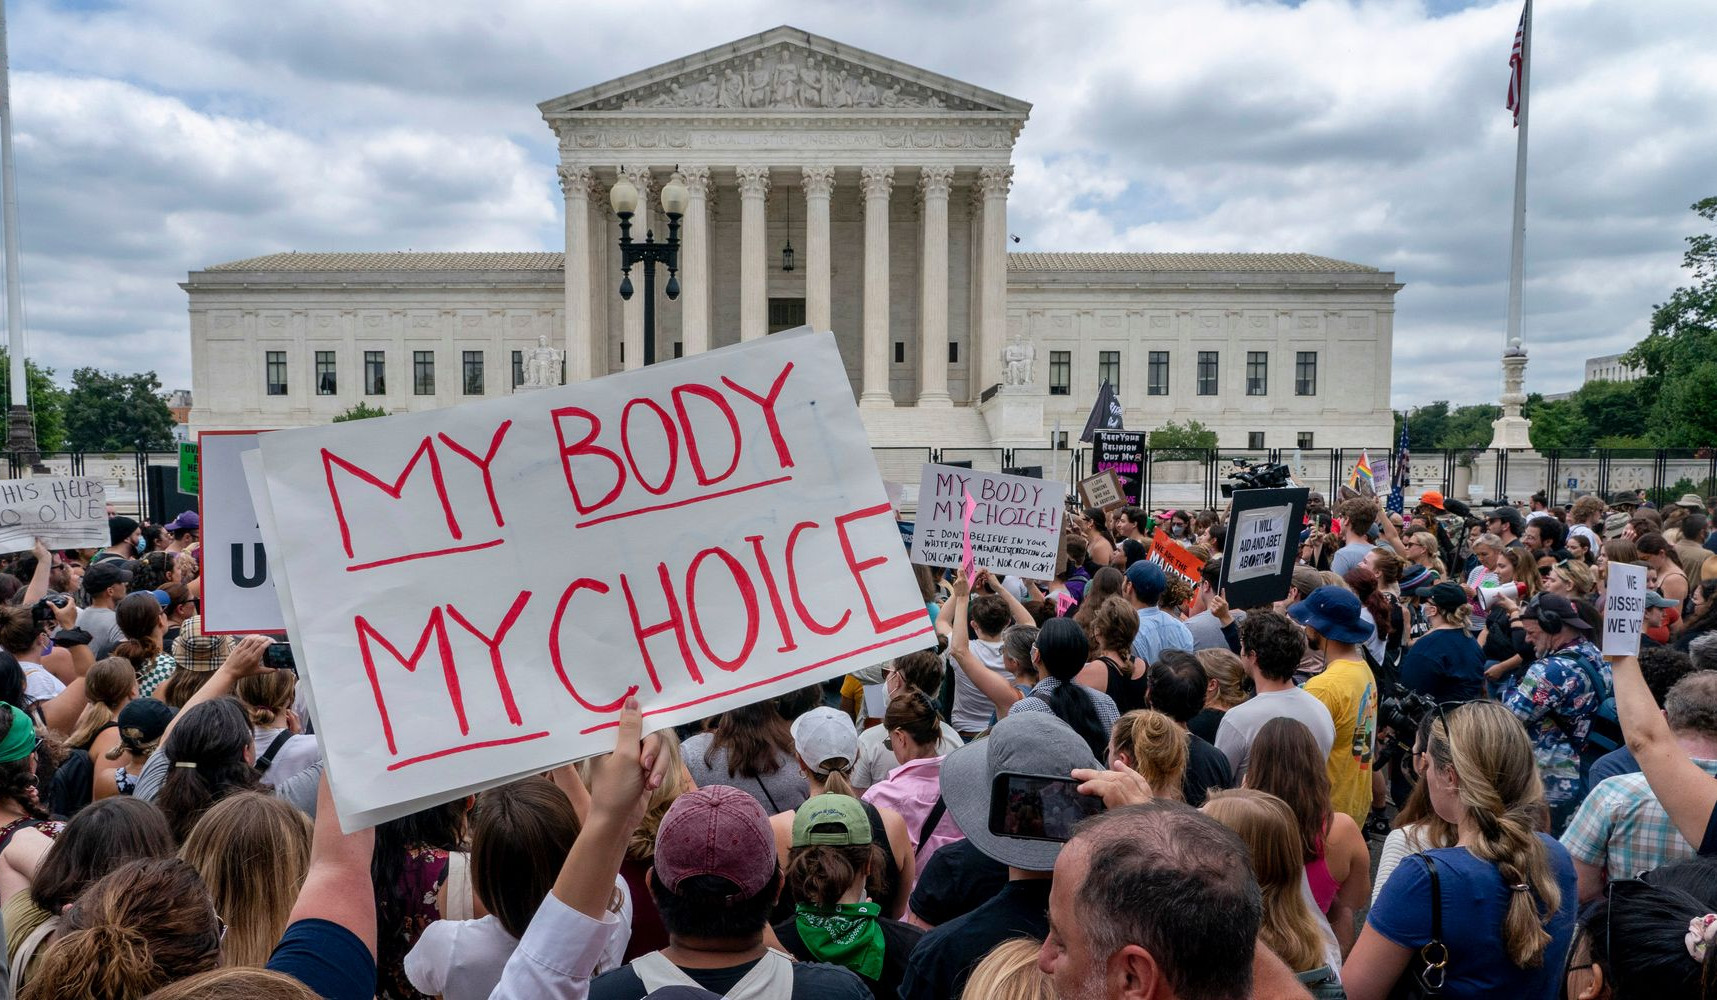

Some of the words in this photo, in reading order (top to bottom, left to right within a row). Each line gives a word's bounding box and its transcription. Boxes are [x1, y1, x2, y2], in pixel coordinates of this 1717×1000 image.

[1101, 433, 1119, 441] KEEP
[1120, 433, 1140, 442] YOUR
[321, 418, 512, 558] MY
[551, 361, 795, 515] BODY
[1, 482, 39, 504] HIS
[52, 480, 104, 502] HELPS
[936, 473, 971, 497] MY
[981, 478, 1043, 507] BODY
[0, 508, 21, 525] O
[39, 500, 102, 523] ONE
[933, 501, 967, 522] MY
[970, 502, 1057, 533] CHOICE!
[1259, 518, 1273, 533] WILL
[926, 529, 935, 538] I
[970, 531, 1008, 544] BELIEVE
[1026, 538, 1048, 548] YOUR
[1239, 539, 1251, 553] AID
[1251, 536, 1265, 550] AND
[1265, 534, 1282, 548] ABET
[922, 550, 937, 562] YOU
[996, 557, 1012, 568] NOR
[1014, 559, 1030, 569] CAN
[1155, 541, 1164, 552] WE
[1164, 550, 1175, 564] ARE
[1175, 559, 1188, 573] THE
[1626, 575, 1637, 590] WE
[354, 590, 532, 755] MY
[549, 502, 928, 714] CHOICE
[1608, 618, 1626, 633] WE
